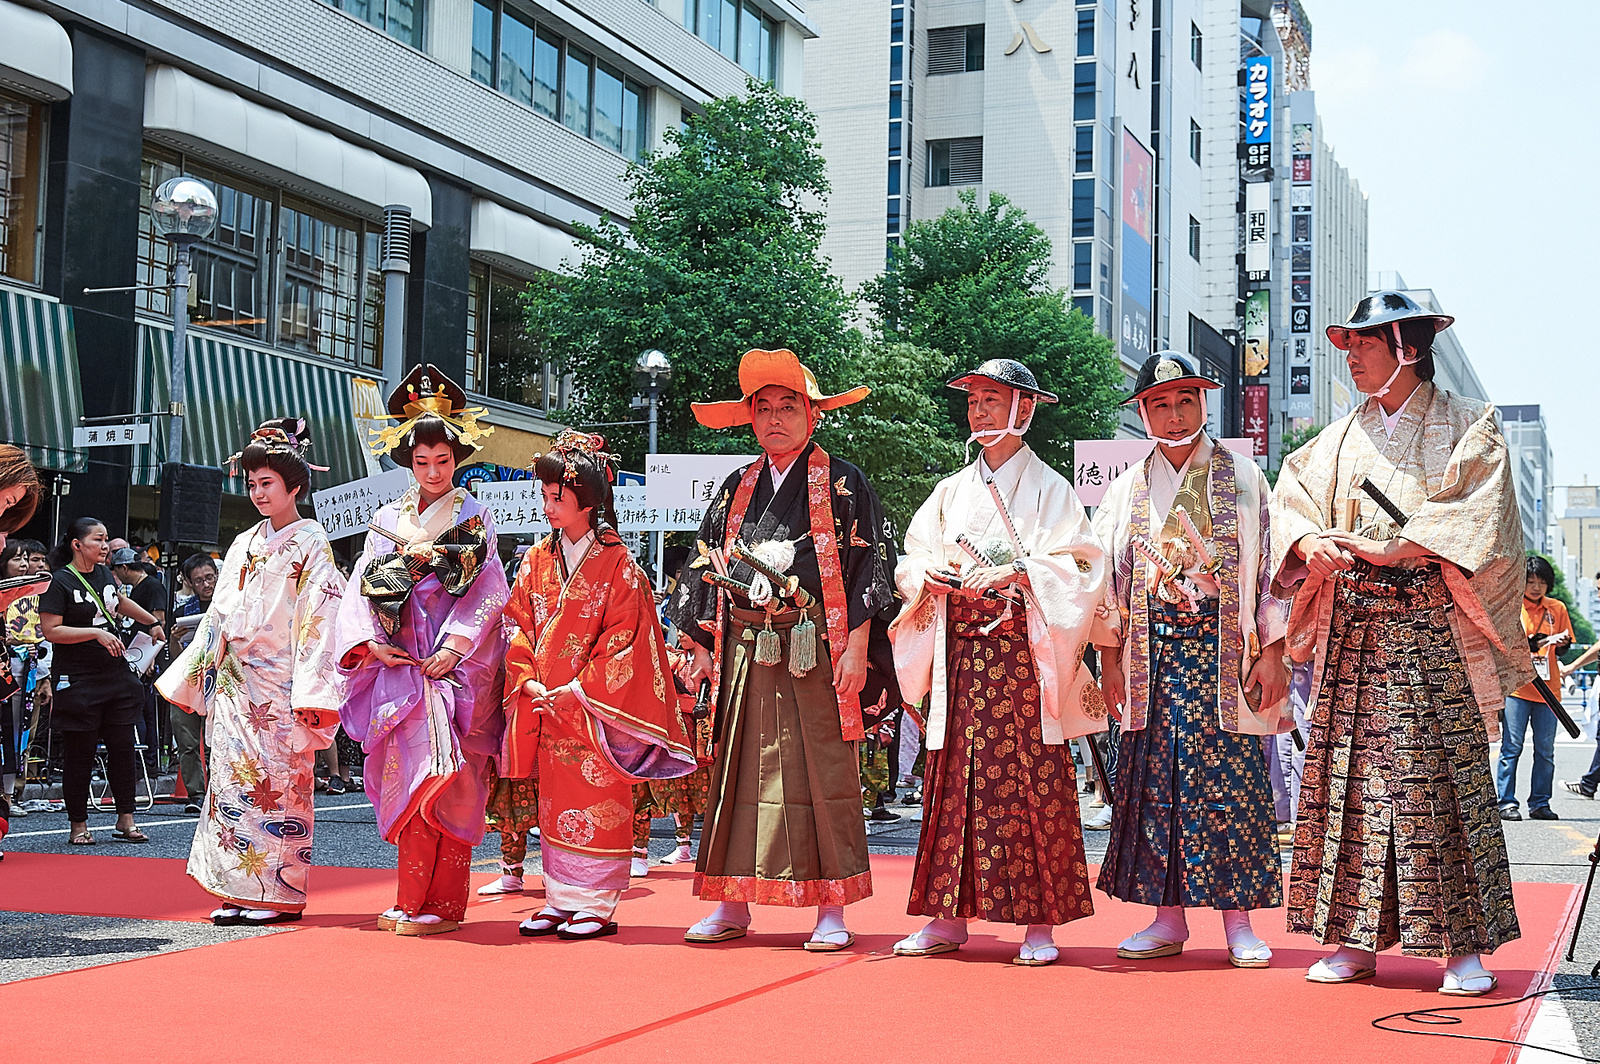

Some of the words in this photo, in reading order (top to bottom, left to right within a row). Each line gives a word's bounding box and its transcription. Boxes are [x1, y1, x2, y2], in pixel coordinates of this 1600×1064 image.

[1249, 63, 1269, 138] カラオケ
[1248, 145, 1270, 155] 6F
[1248, 155, 1269, 165] 5F
[1250, 212, 1266, 242] 和民
[1290, 401, 1311, 412] ARK
[87, 428, 134, 443] 蒲焼町
